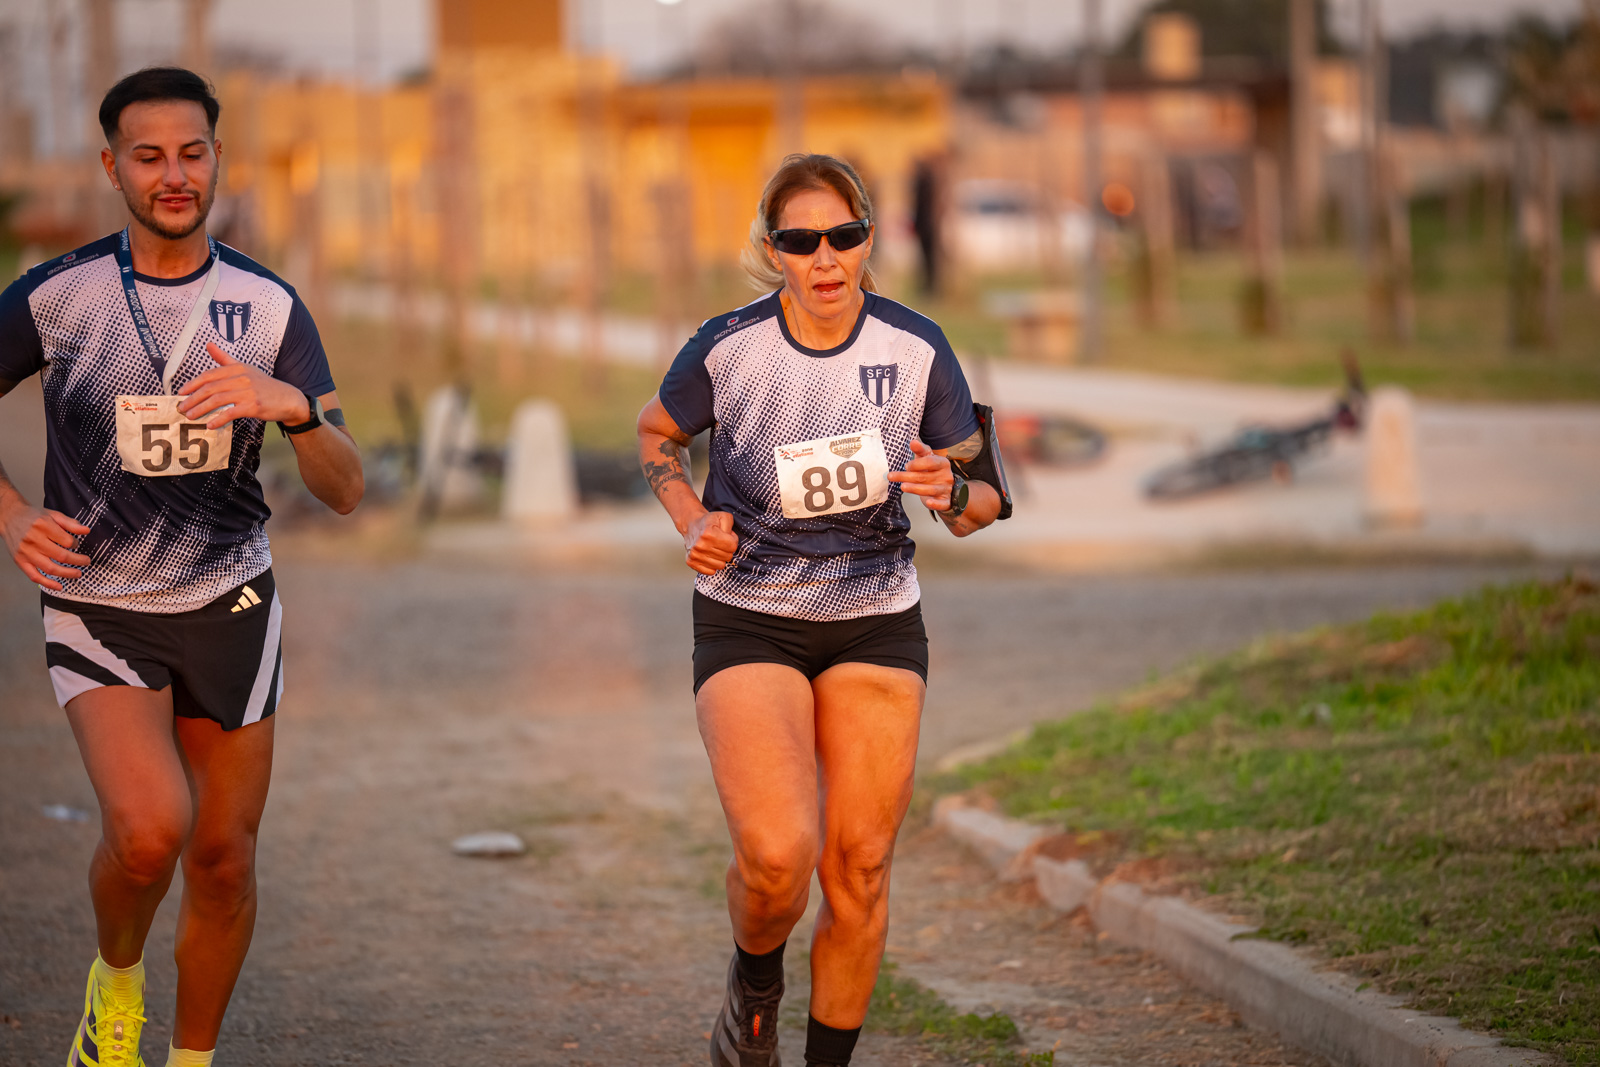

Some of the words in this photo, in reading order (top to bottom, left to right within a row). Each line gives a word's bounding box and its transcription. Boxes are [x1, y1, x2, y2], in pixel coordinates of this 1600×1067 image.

[216, 303, 244, 315] SFC
[134, 311, 147, 326] QUE
[866, 367, 891, 379] SFC
[141, 423, 210, 473] 55
[830, 436, 862, 448] ALVAREZ
[831, 442, 862, 453] CORRE
[801, 460, 868, 513] 89
